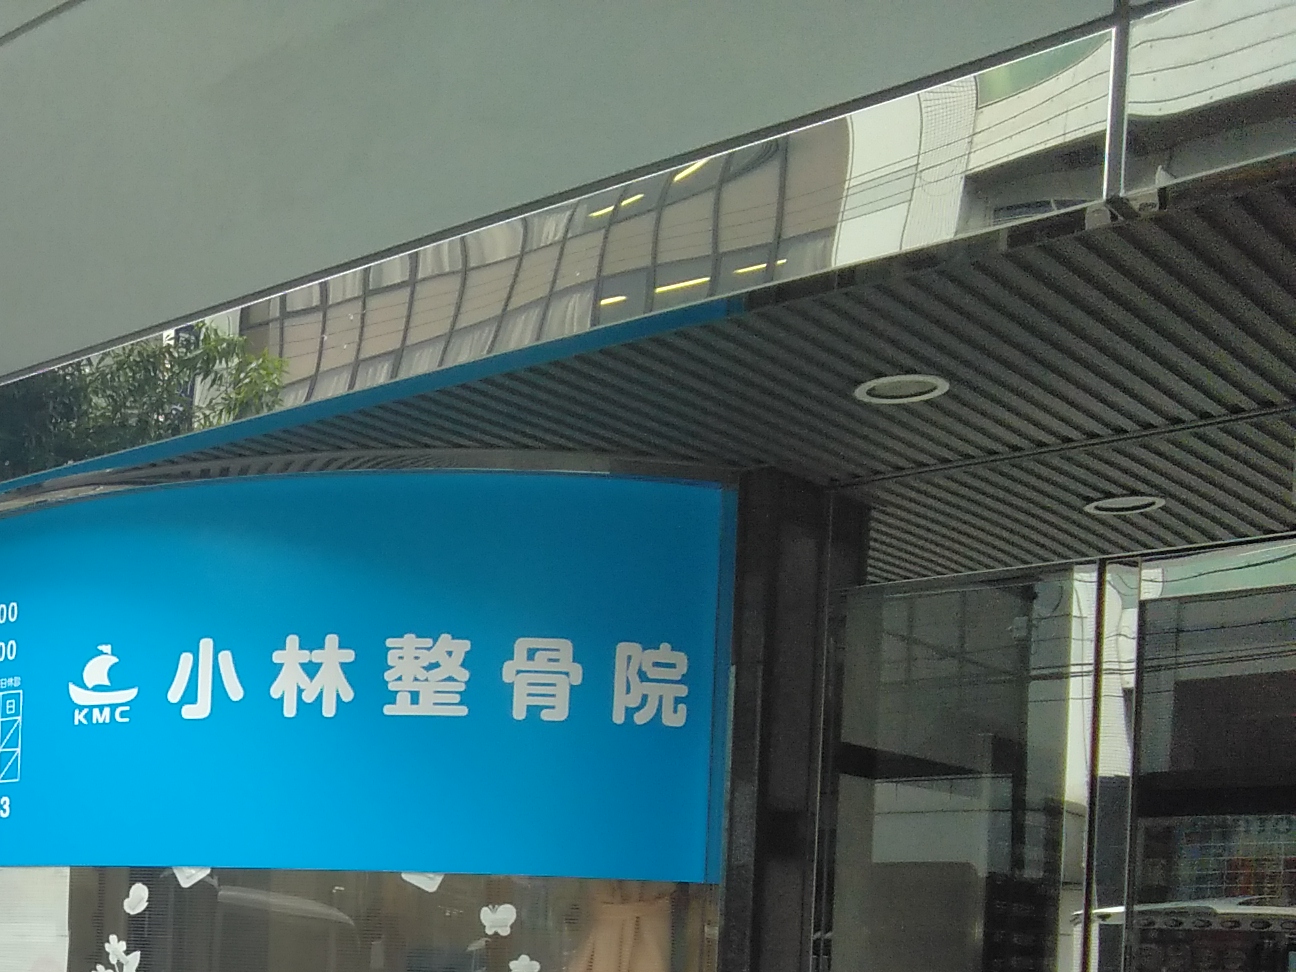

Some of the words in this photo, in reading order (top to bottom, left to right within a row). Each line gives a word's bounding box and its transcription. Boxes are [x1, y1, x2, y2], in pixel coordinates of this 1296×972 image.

[166, 633, 689, 727] 小林整骨院
[6, 699, 16, 714] 日
[73, 706, 131, 725] KMC
